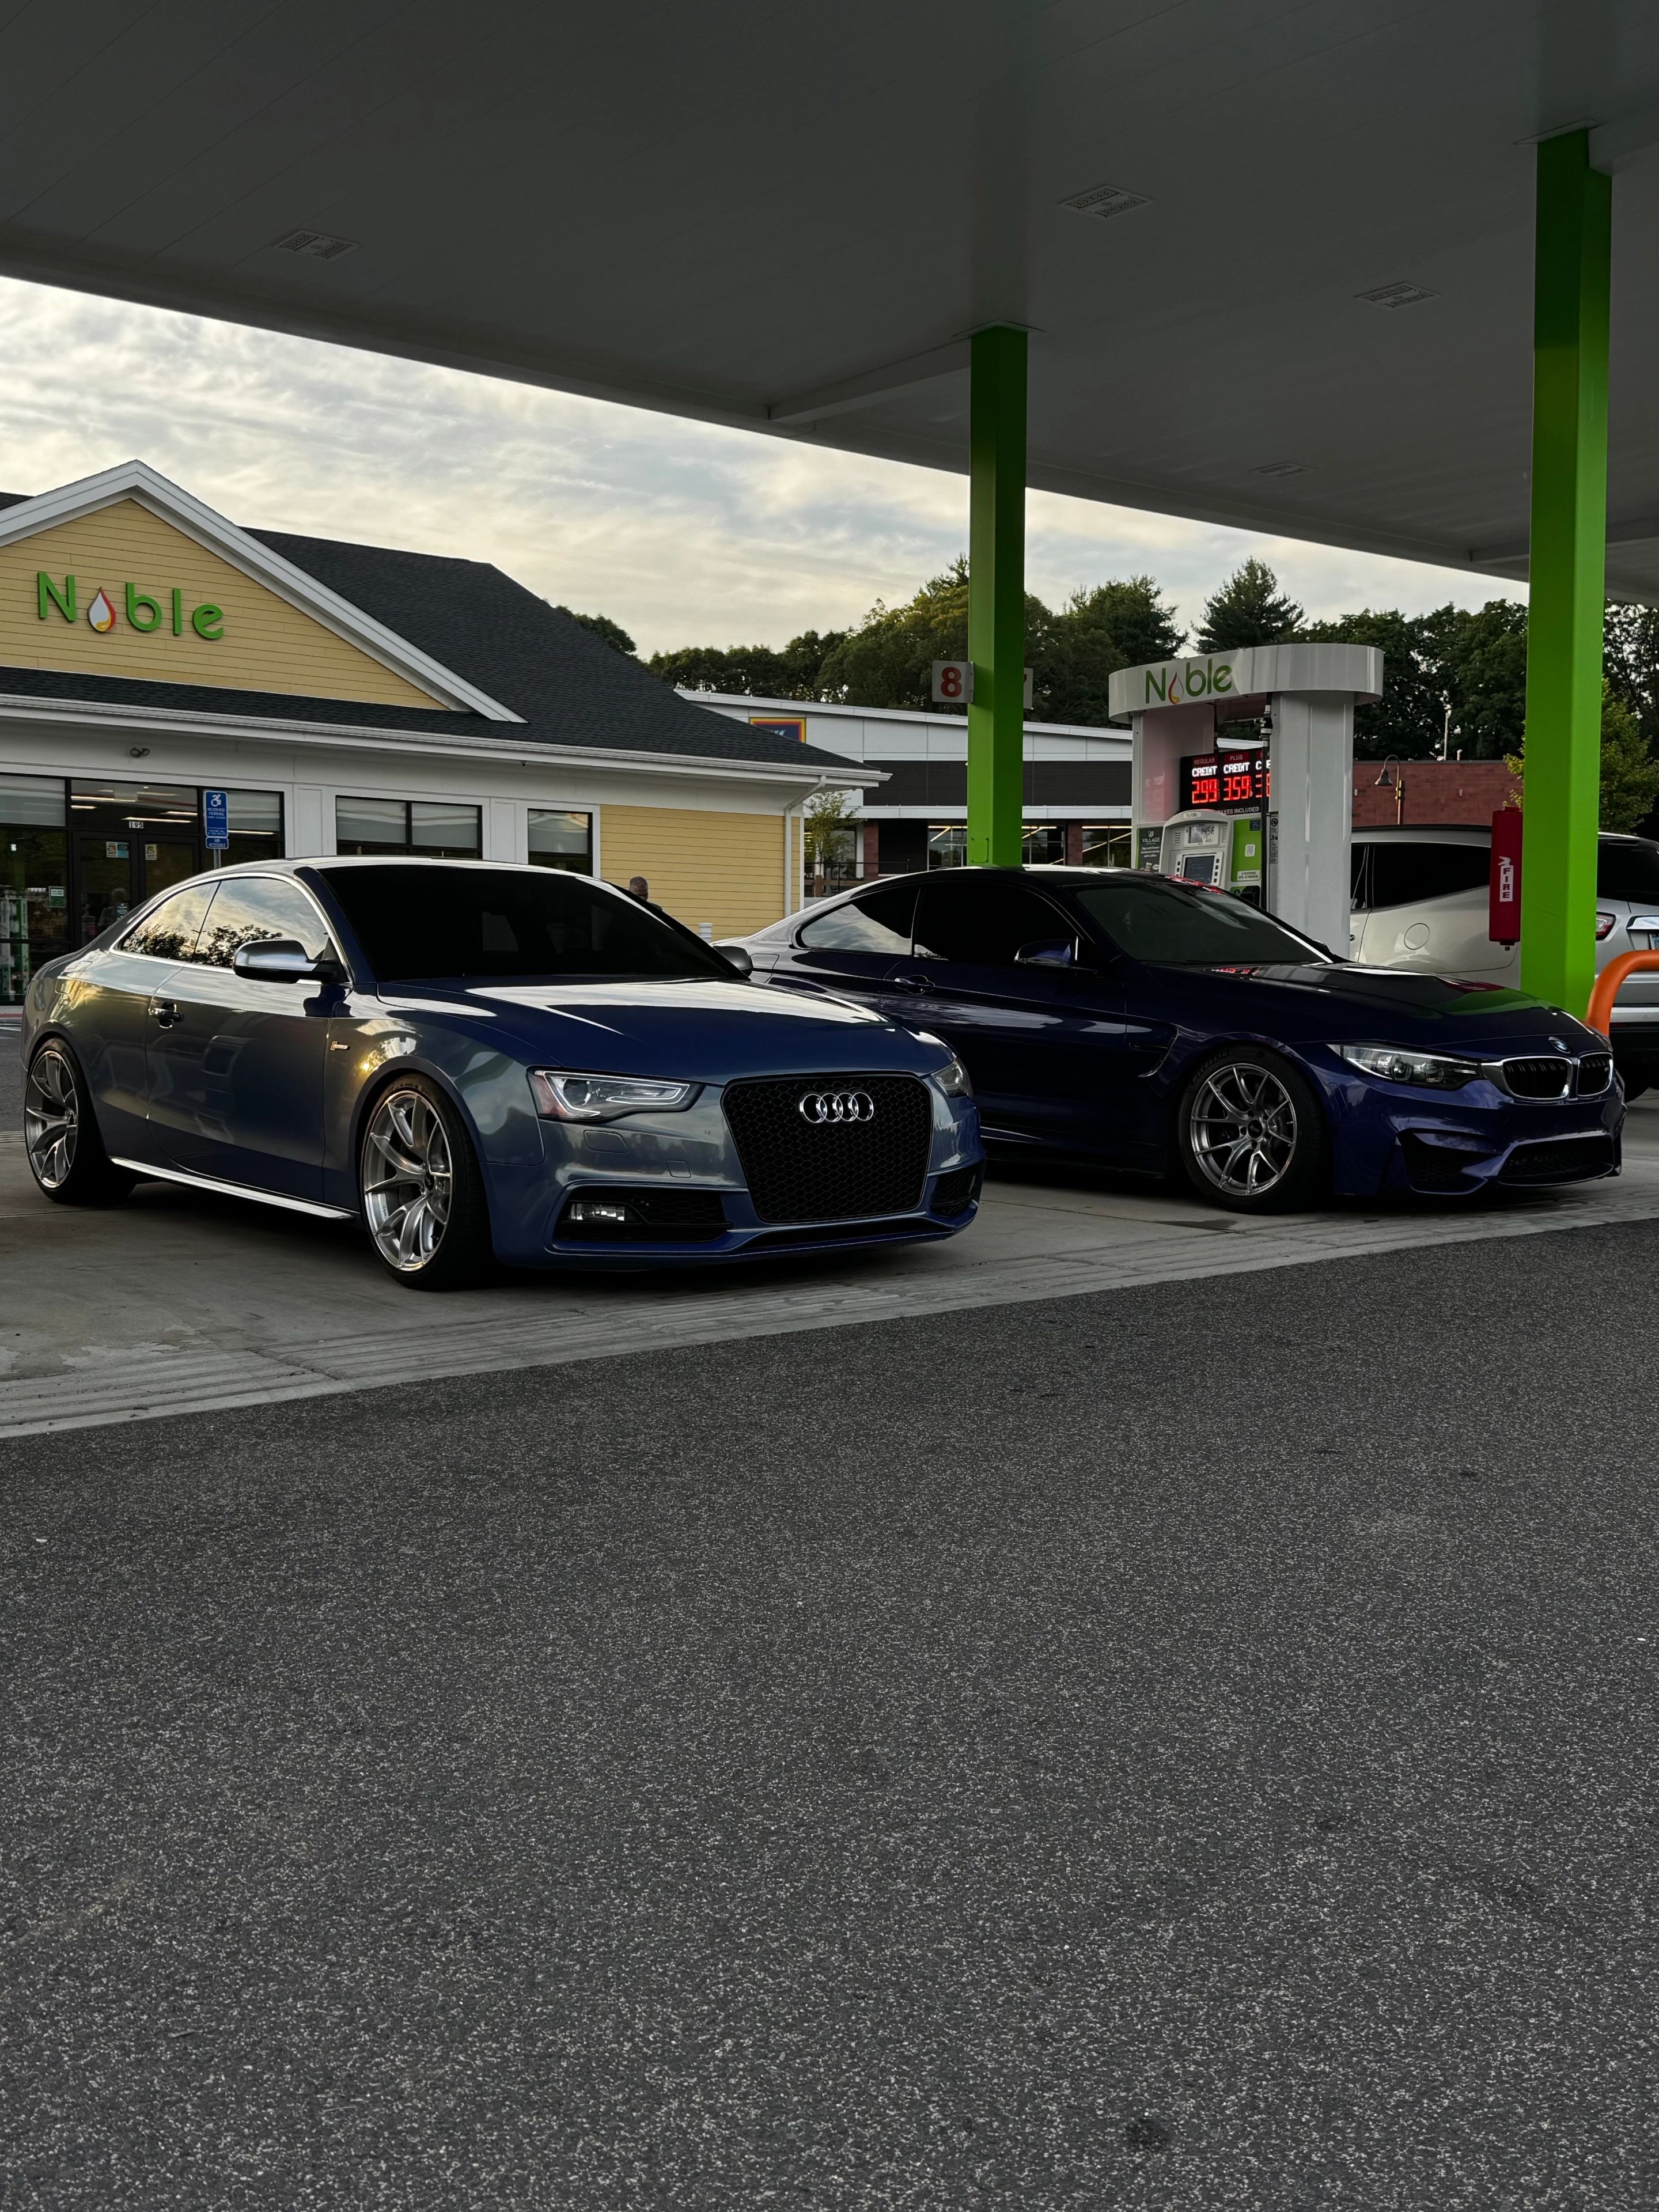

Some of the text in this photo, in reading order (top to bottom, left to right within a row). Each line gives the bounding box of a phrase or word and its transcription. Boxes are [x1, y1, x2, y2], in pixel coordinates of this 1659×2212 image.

[940, 666, 963, 698] 8
[1192, 766, 1218, 777] CREDIT
[1223, 762, 1250, 774] CREDIT
[1502, 868, 1512, 899] FIRE
